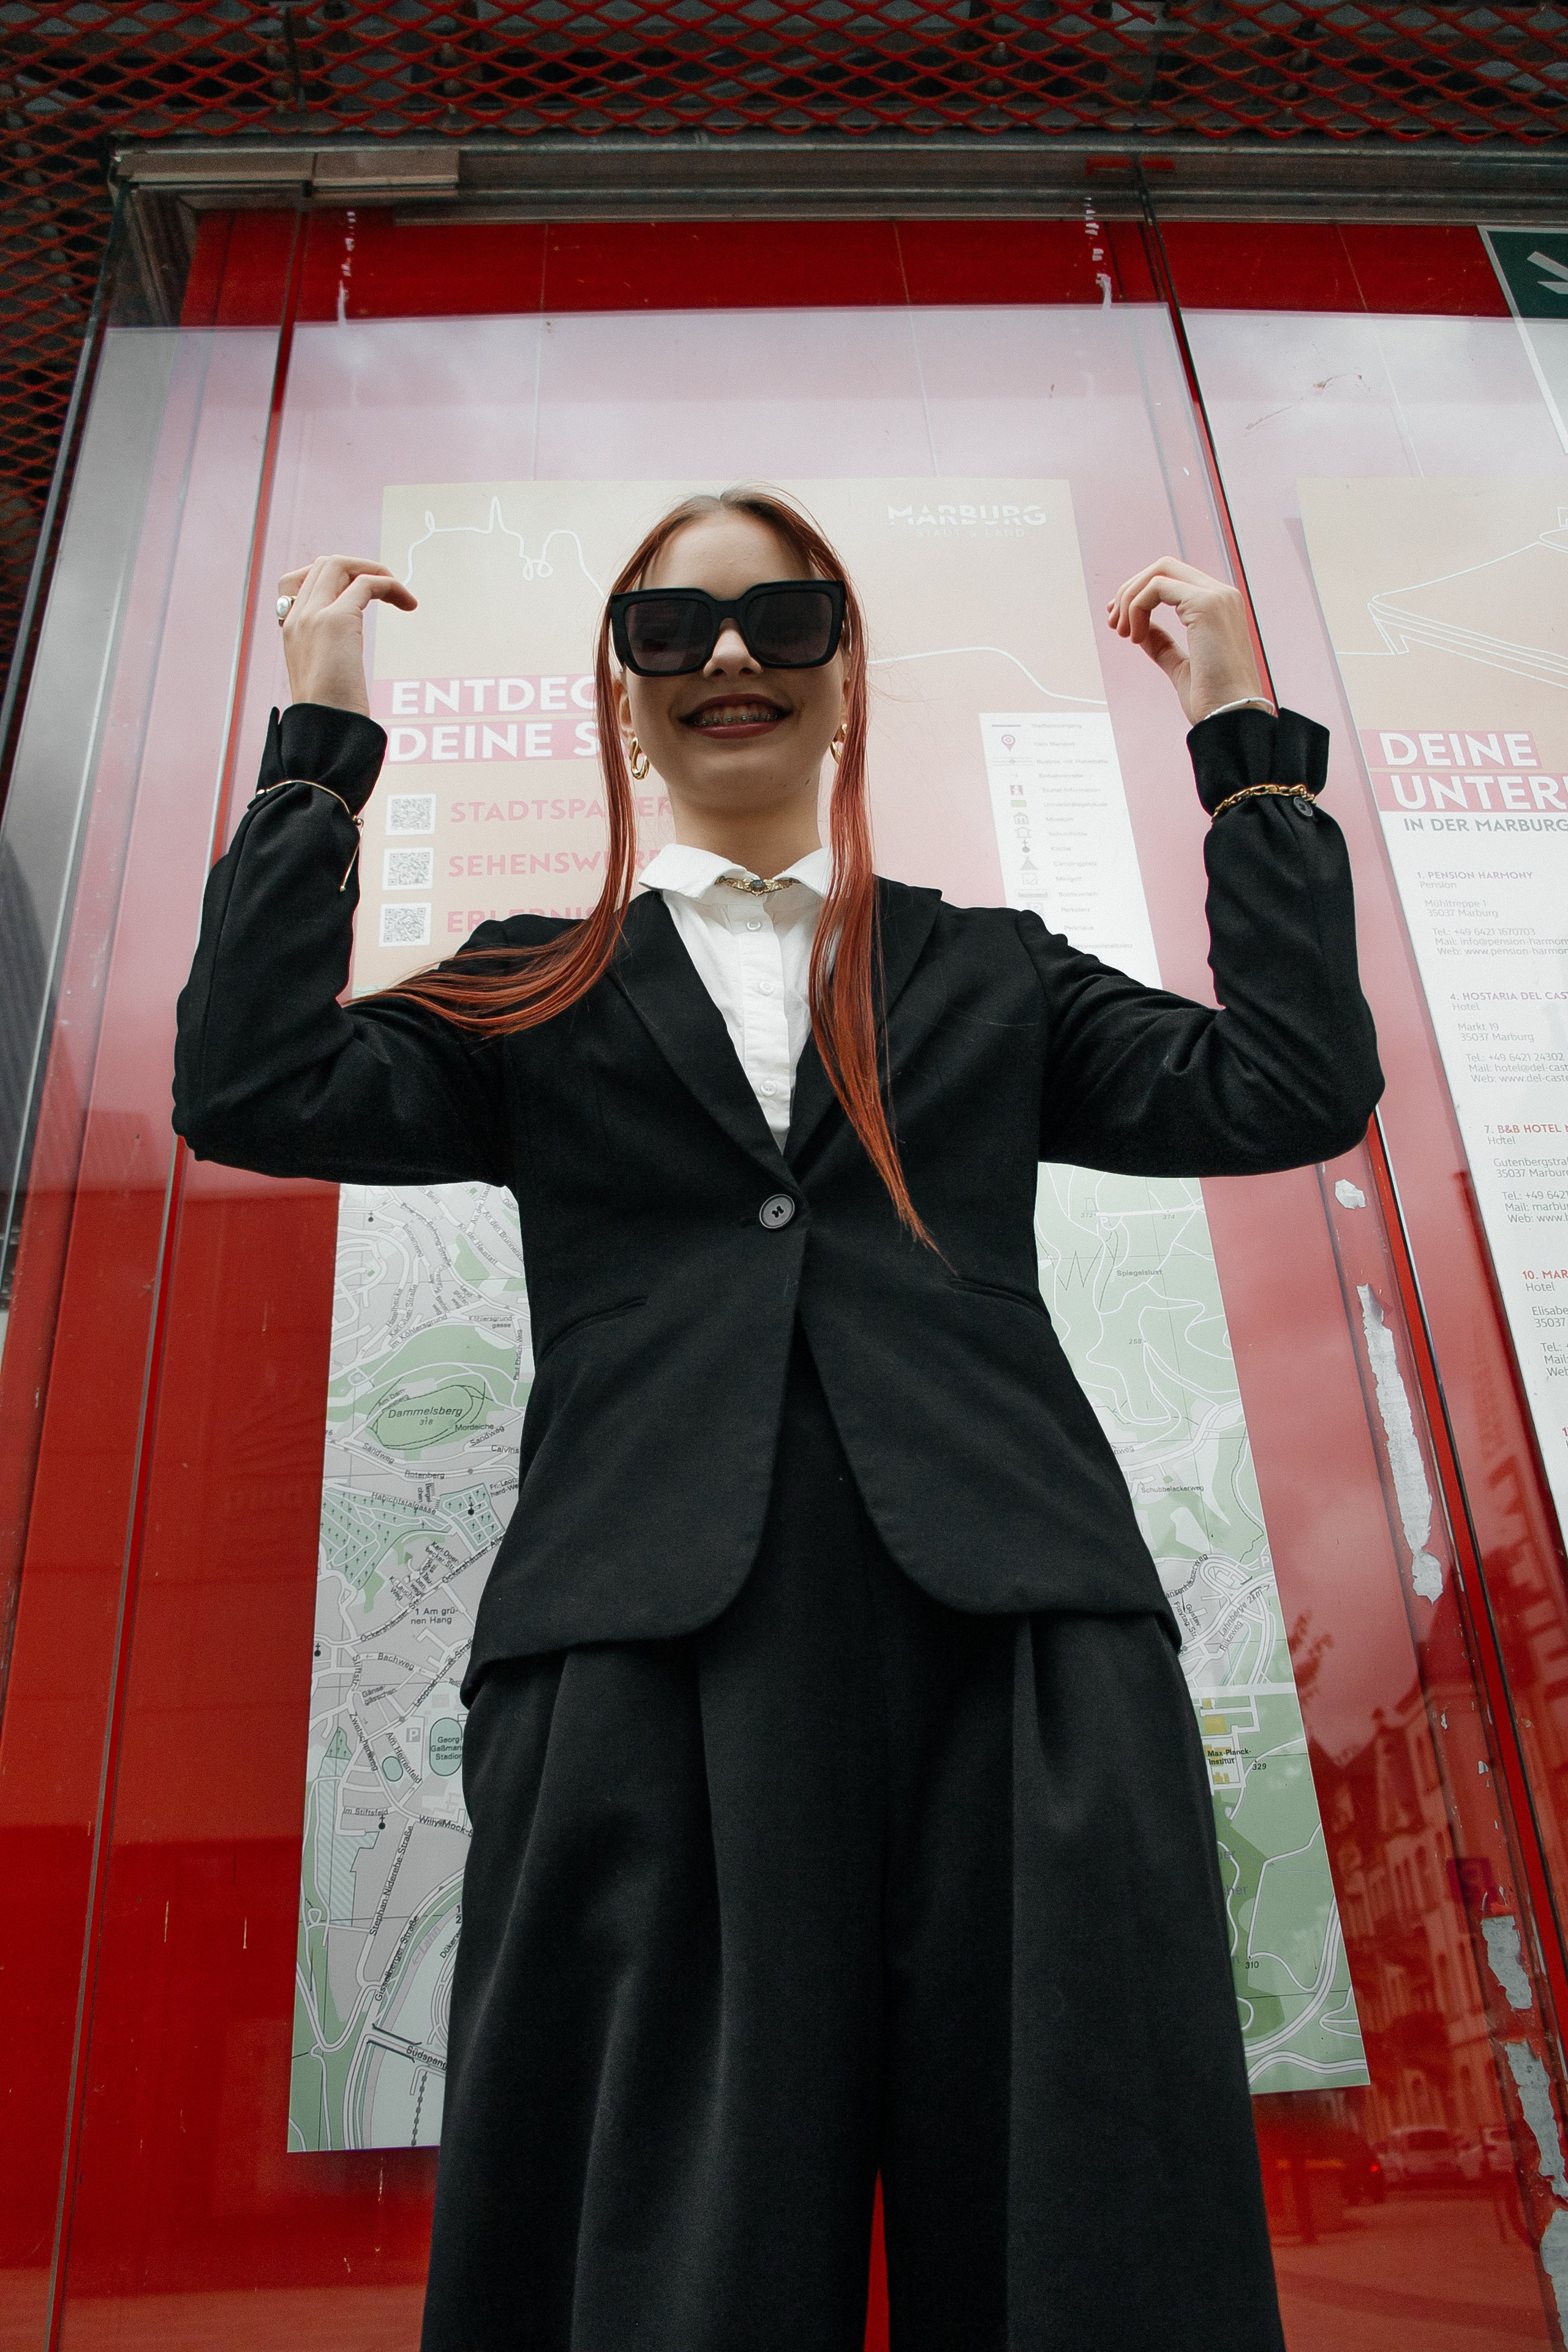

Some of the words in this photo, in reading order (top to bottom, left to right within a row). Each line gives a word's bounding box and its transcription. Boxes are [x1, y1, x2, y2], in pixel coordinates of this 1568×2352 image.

[888, 505, 1046, 526] MARBURG
[389, 723, 552, 762] DEINE
[1379, 733, 1537, 766] DEINE
[1391, 775, 1568, 810] UNTER
[451, 797, 672, 823] STADTSPAER
[1404, 818, 1424, 831] IN
[1431, 818, 1469, 832] DER
[448, 850, 660, 876] SEHENSWR
[1427, 871, 1475, 880] PENSION
[1478, 871, 1532, 880] HARMONY
[1419, 880, 1457, 889] Pension
[1425, 899, 1480, 909] Mühltreppe
[1457, 909, 1499, 919] Marburg
[1437, 947, 1462, 956] Web:
[1462, 992, 1518, 1001] HOSTARIA
[1520, 992, 1542, 1000] DEL
[1489, 1022, 1499, 1031] 19
[1492, 1033, 1534, 1042] Marburg
[1509, 1053, 1531, 1061] 6421
[1534, 1053, 1565, 1061] 24302
[1471, 1074, 1496, 1083] Web:
[1483, 1125, 1494, 1134] 7.
[1497, 1125, 1520, 1133] B&B
[1523, 1124, 1562, 1133] HOTEL
[1487, 1136, 1516, 1145] Hotel
[1496, 1169, 1526, 1178] 35037
[1525, 1191, 1544, 1199] +49
[1504, 1202, 1529, 1212] Mail:
[1507, 1213, 1534, 1223] Web:
[491, 1219, 500, 1232] den
[402, 1224, 424, 1258] Bienenweg
[467, 1231, 477, 1243] der
[1522, 1270, 1539, 1280] 10.
[1542, 1269, 1568, 1279] MAR
[1525, 1281, 1556, 1292] Hotel
[1531, 1305, 1568, 1316] Elisabe
[399, 1314, 449, 1341] Köhlersgrund
[1534, 1317, 1566, 1328] 35037
[388, 1406, 463, 1419] Dammelsberg
[455, 1423, 494, 1431] Mordeiche
[469, 1425, 505, 1447] Sandweg
[362, 1442, 396, 1464] Sandweg
[404, 1470, 446, 1480] Rotenberg
[371, 1491, 437, 1515] Habichtstalgasse
[442, 1548, 489, 1584] Ockershäuser
[442, 1608, 459, 1616] grü-
[1218, 1601, 1247, 1637] Lahnberge
[1246, 1589, 1262, 1604] 2km
[360, 1609, 409, 1643] Ockershäuser
[1219, 1620, 1243, 1651] Rilkeweg
[378, 1653, 415, 1672] Bachweg
[350, 1711, 379, 1772] Zwetschenweg
[1207, 1747, 1251, 1757] Max-Planck-
[386, 1732, 396, 1747] Am
[394, 1746, 423, 1784] Herrenfeld
[355, 1807, 389, 1815] Stiftsfeld
[369, 1825, 413, 1936] Stephan-Niderehe-Straße
[456, 1904, 461, 1913] 1
[455, 1915, 461, 1924] 2
[375, 1945, 404, 2002] Gisselberger
[400, 1914, 420, 1945] Straße
